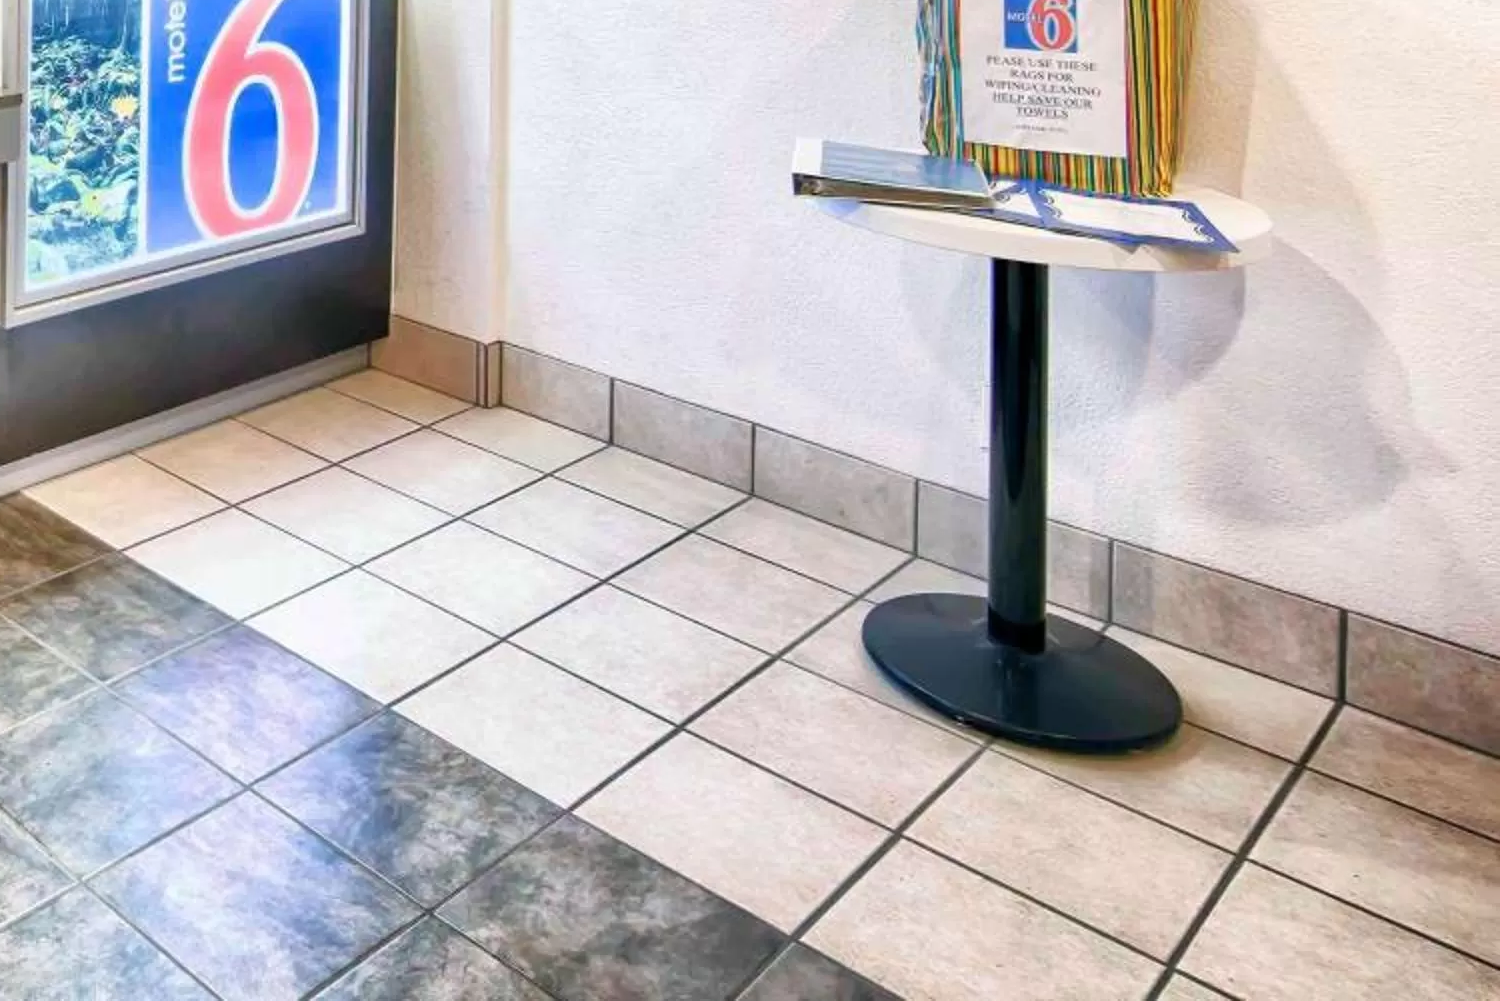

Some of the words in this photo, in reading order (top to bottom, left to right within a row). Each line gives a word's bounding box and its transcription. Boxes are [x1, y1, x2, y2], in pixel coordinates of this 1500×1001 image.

[1027, 57, 1053, 68] USE
[1056, 60, 1098, 72] THESE
[1010, 69, 1045, 80] RAGS
[1047, 71, 1074, 83] FOR
[992, 92, 1025, 104] HELP
[1027, 94, 1061, 106] SAVE
[1063, 97, 1093, 110] OUR
[1016, 105, 1069, 119] TOWELS
